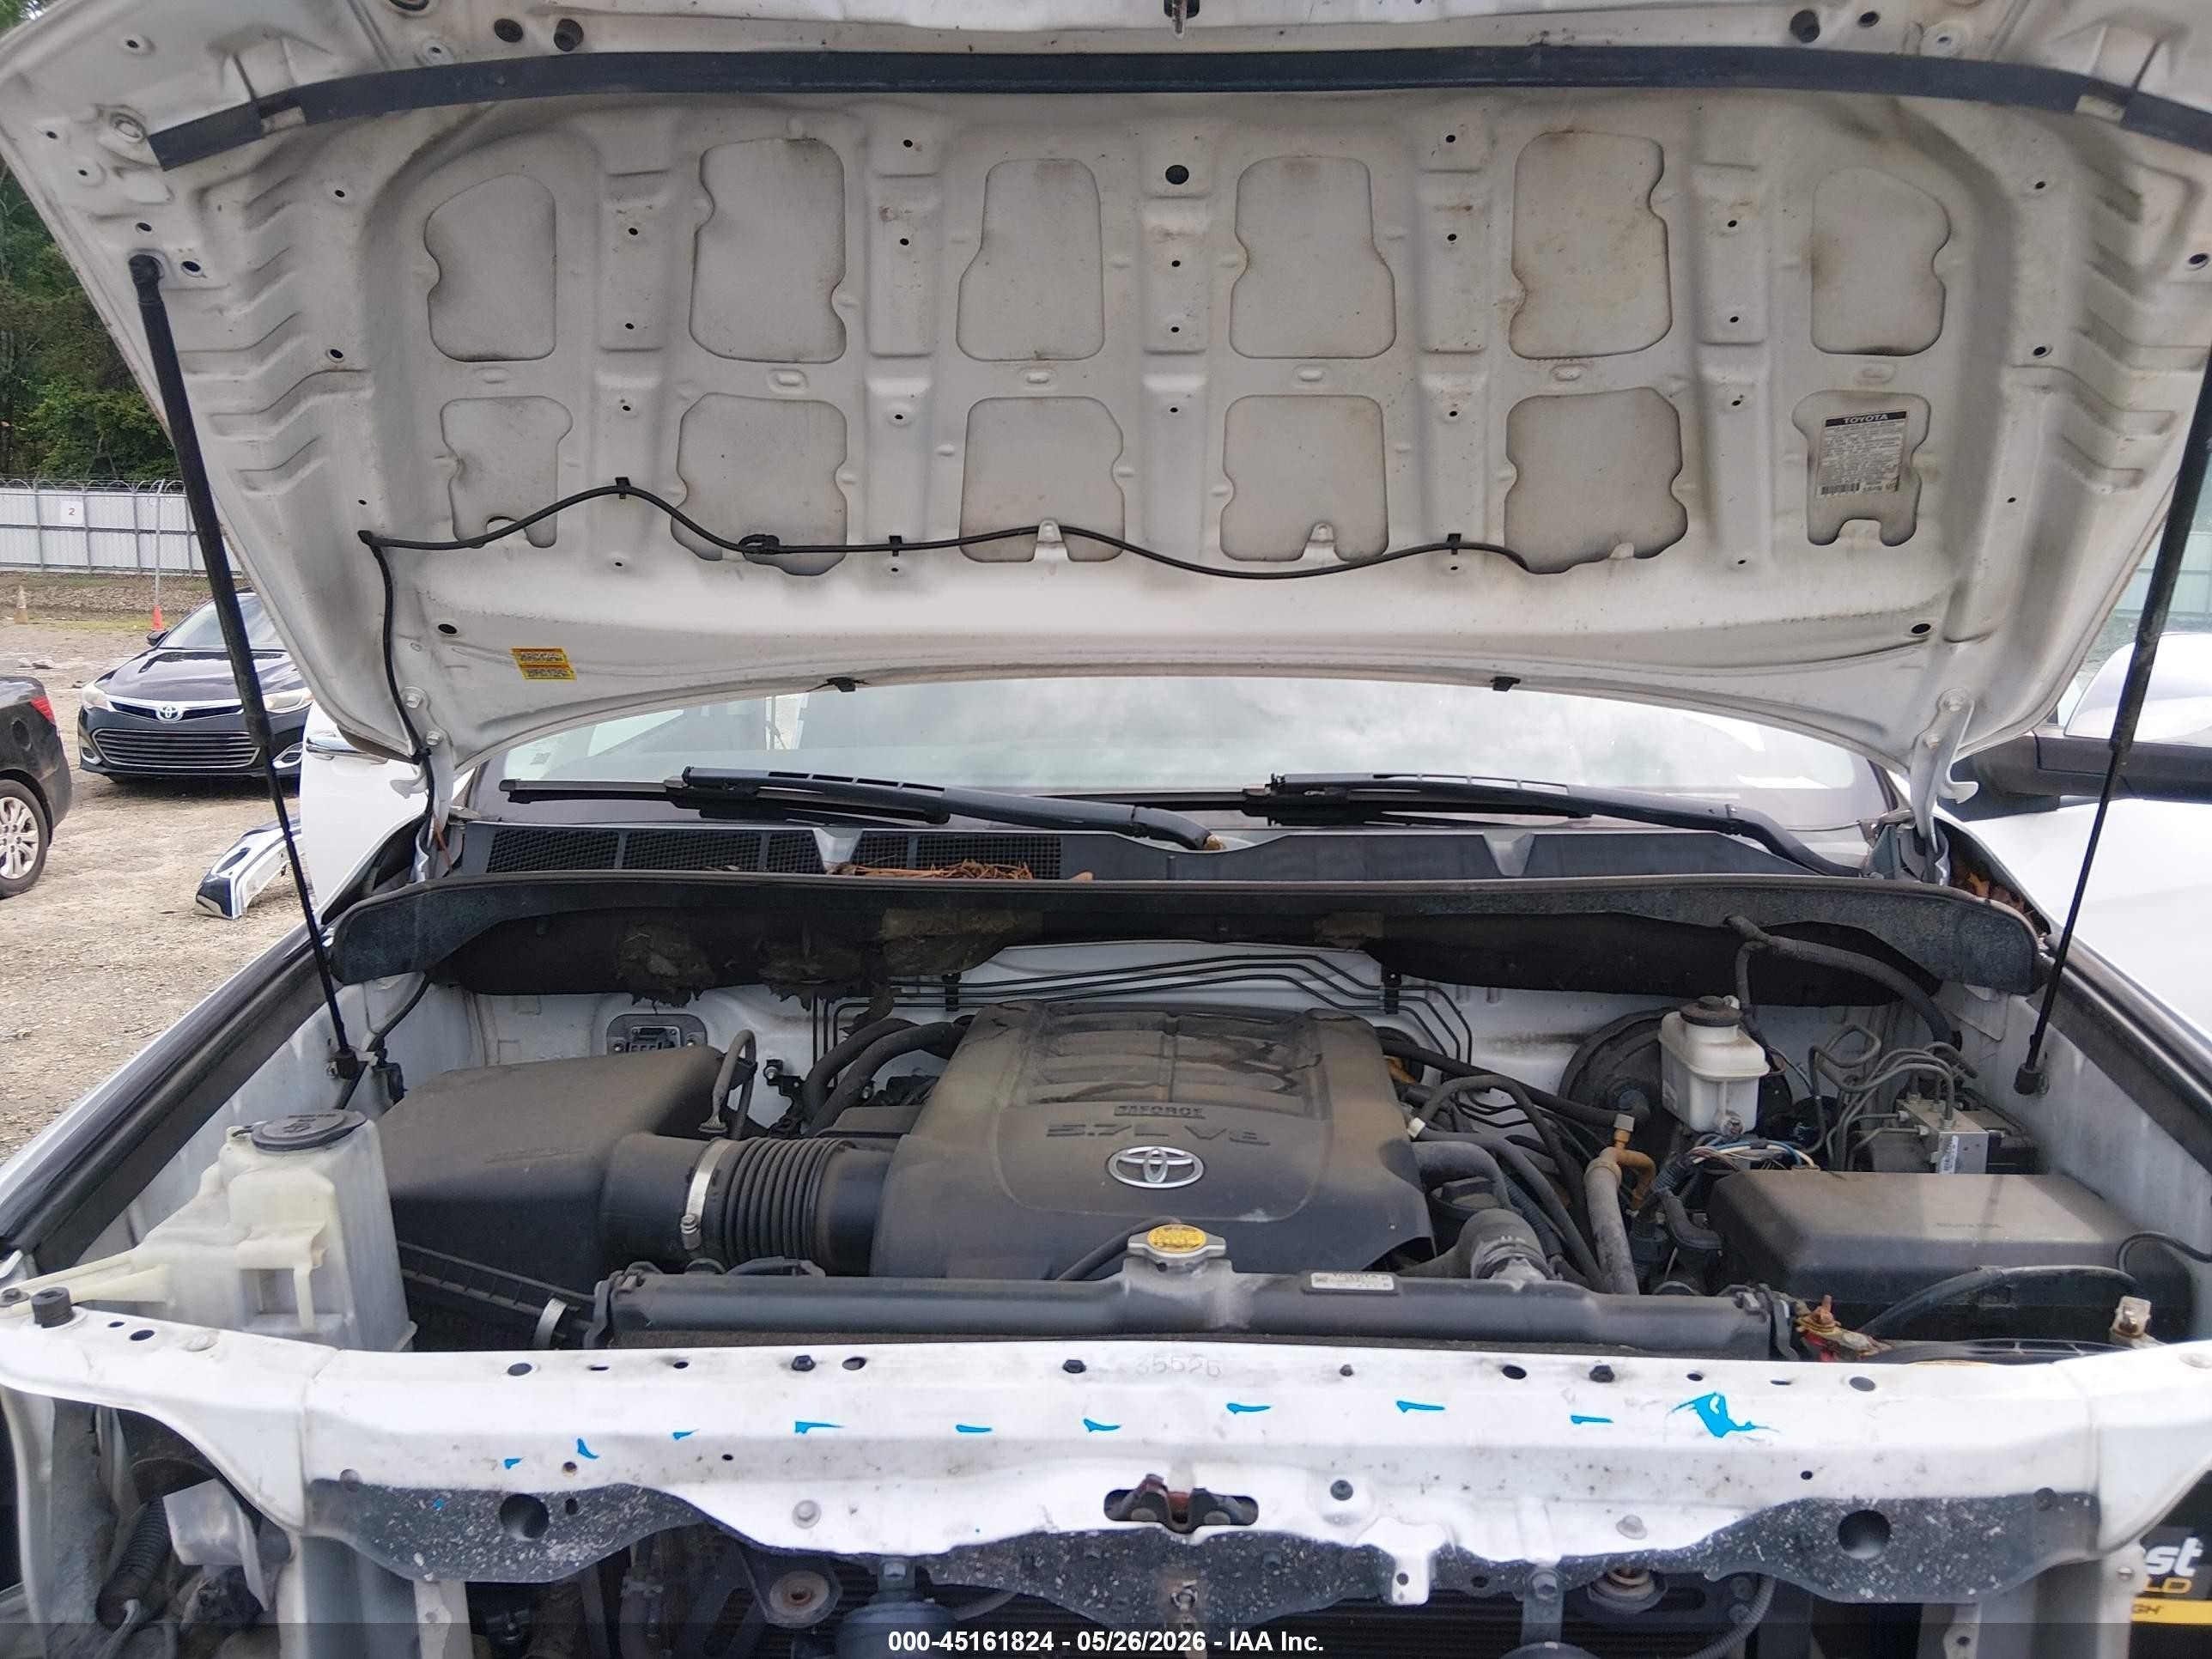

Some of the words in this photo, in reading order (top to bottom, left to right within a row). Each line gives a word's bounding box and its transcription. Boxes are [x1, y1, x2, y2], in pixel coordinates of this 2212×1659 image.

[1843, 414, 1889, 424] TOYOTA
[68, 507, 76, 516] 2
[2144, 1536, 2203, 1577] st
[2143, 1577, 2192, 1594] LD
